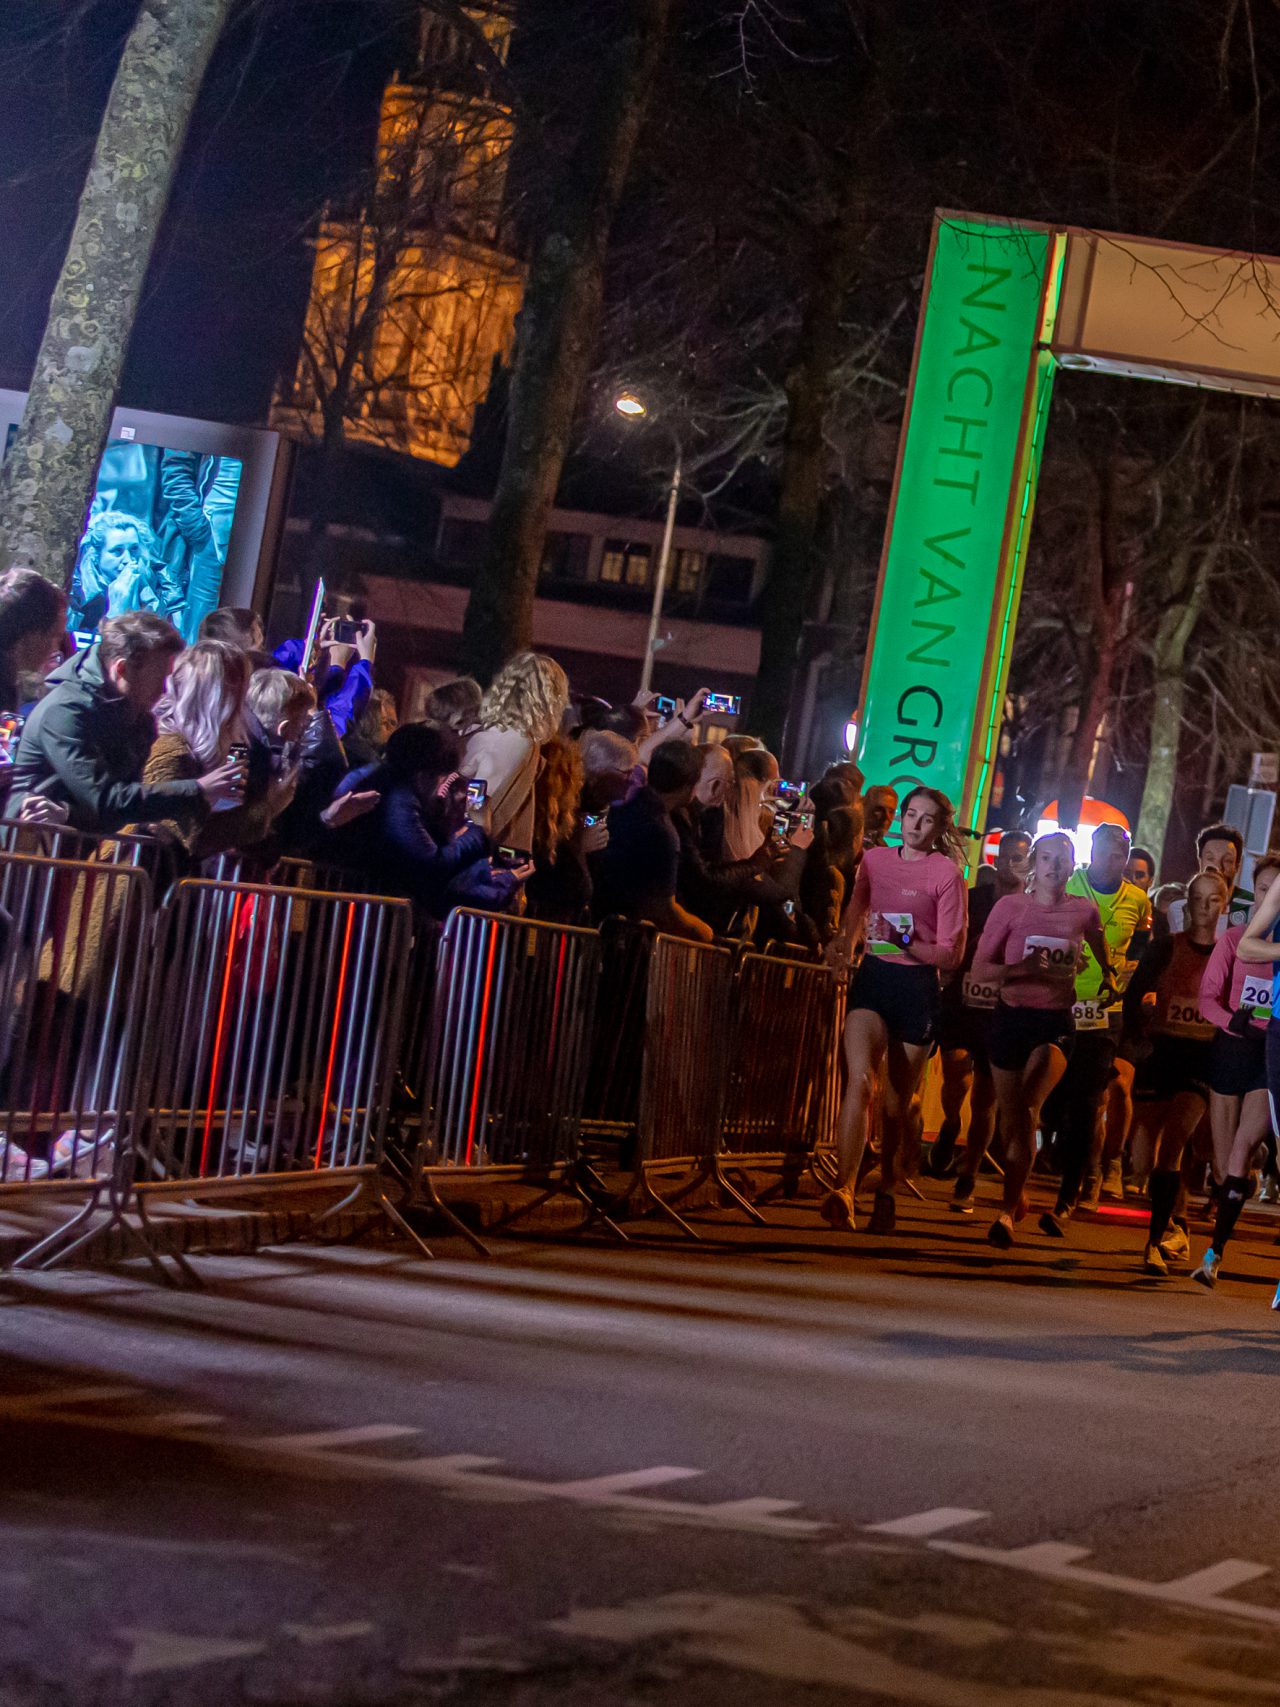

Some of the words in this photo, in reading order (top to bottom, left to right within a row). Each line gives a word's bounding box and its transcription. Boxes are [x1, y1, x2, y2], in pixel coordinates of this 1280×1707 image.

[933, 262, 1011, 506] NACHT
[905, 527, 972, 668] VAN
[888, 684, 943, 787] GR
[1244, 986, 1271, 1005] 20
